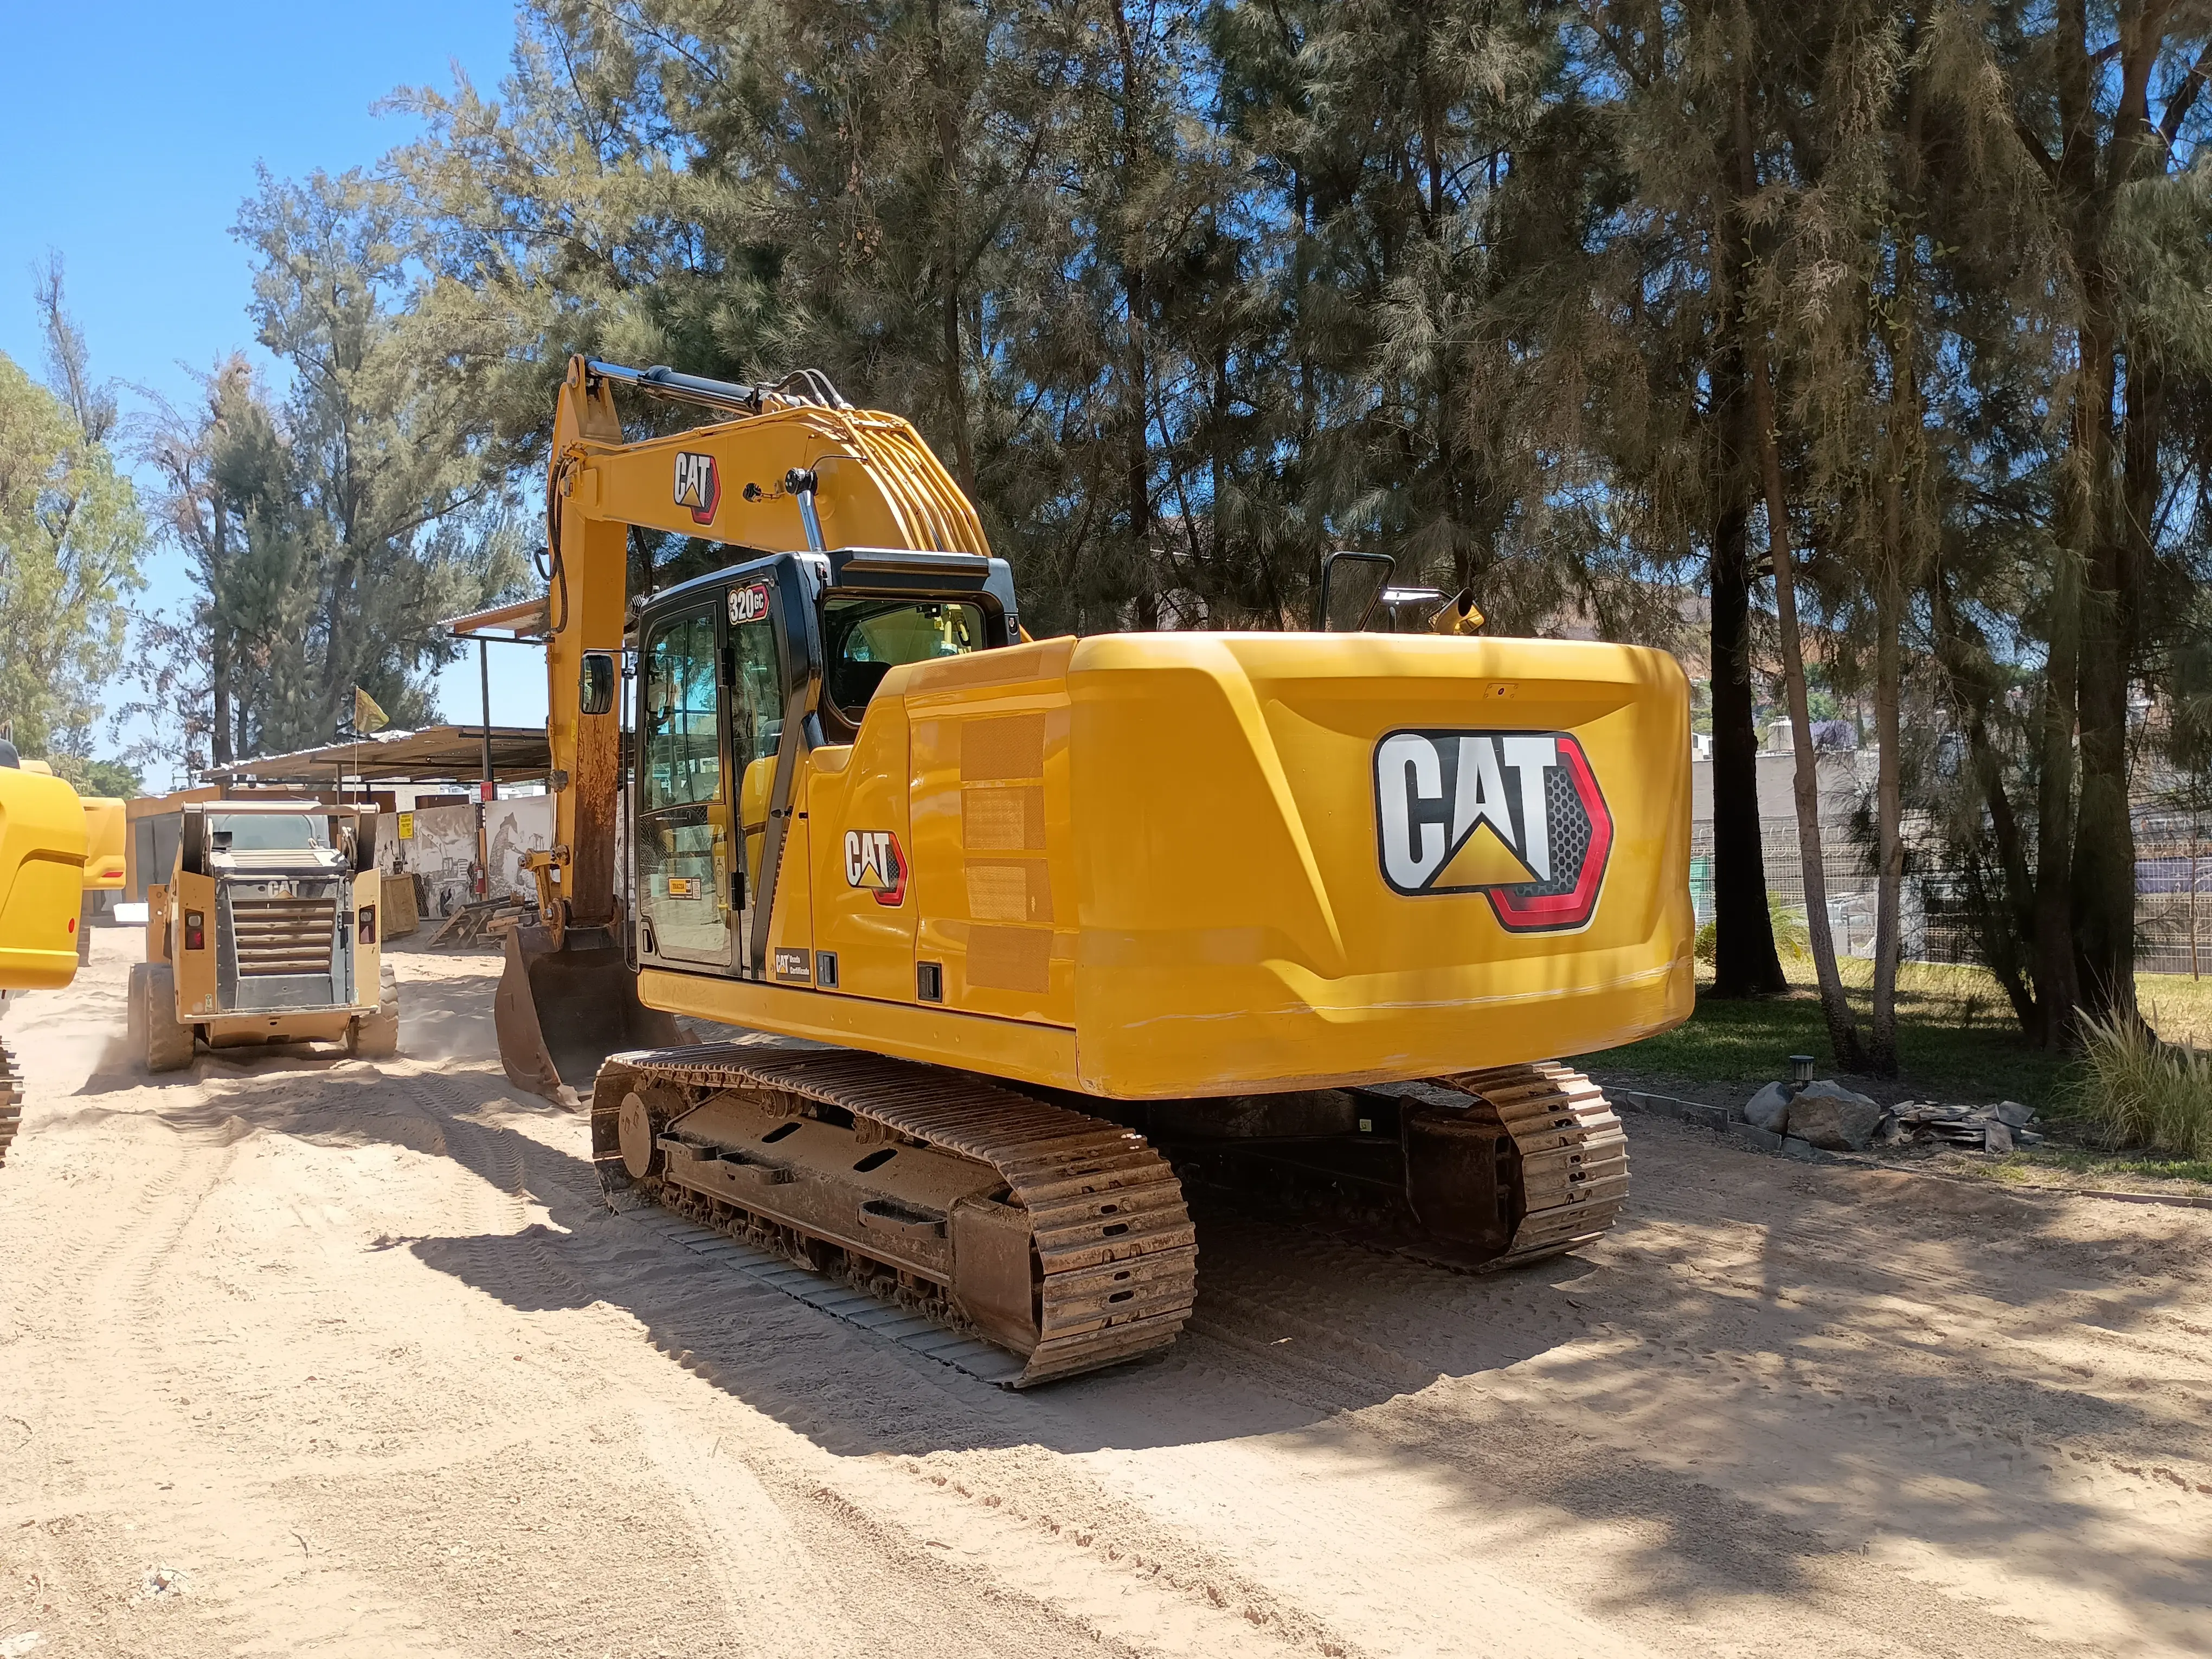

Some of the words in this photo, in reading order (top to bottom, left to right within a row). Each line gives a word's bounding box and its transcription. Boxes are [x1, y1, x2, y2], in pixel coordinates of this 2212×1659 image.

[674, 453, 710, 507] CAT
[1378, 734, 1557, 889] CAT
[845, 831, 889, 888] CAT
[268, 880, 299, 898] CAT
[776, 955, 789, 974] CAT
